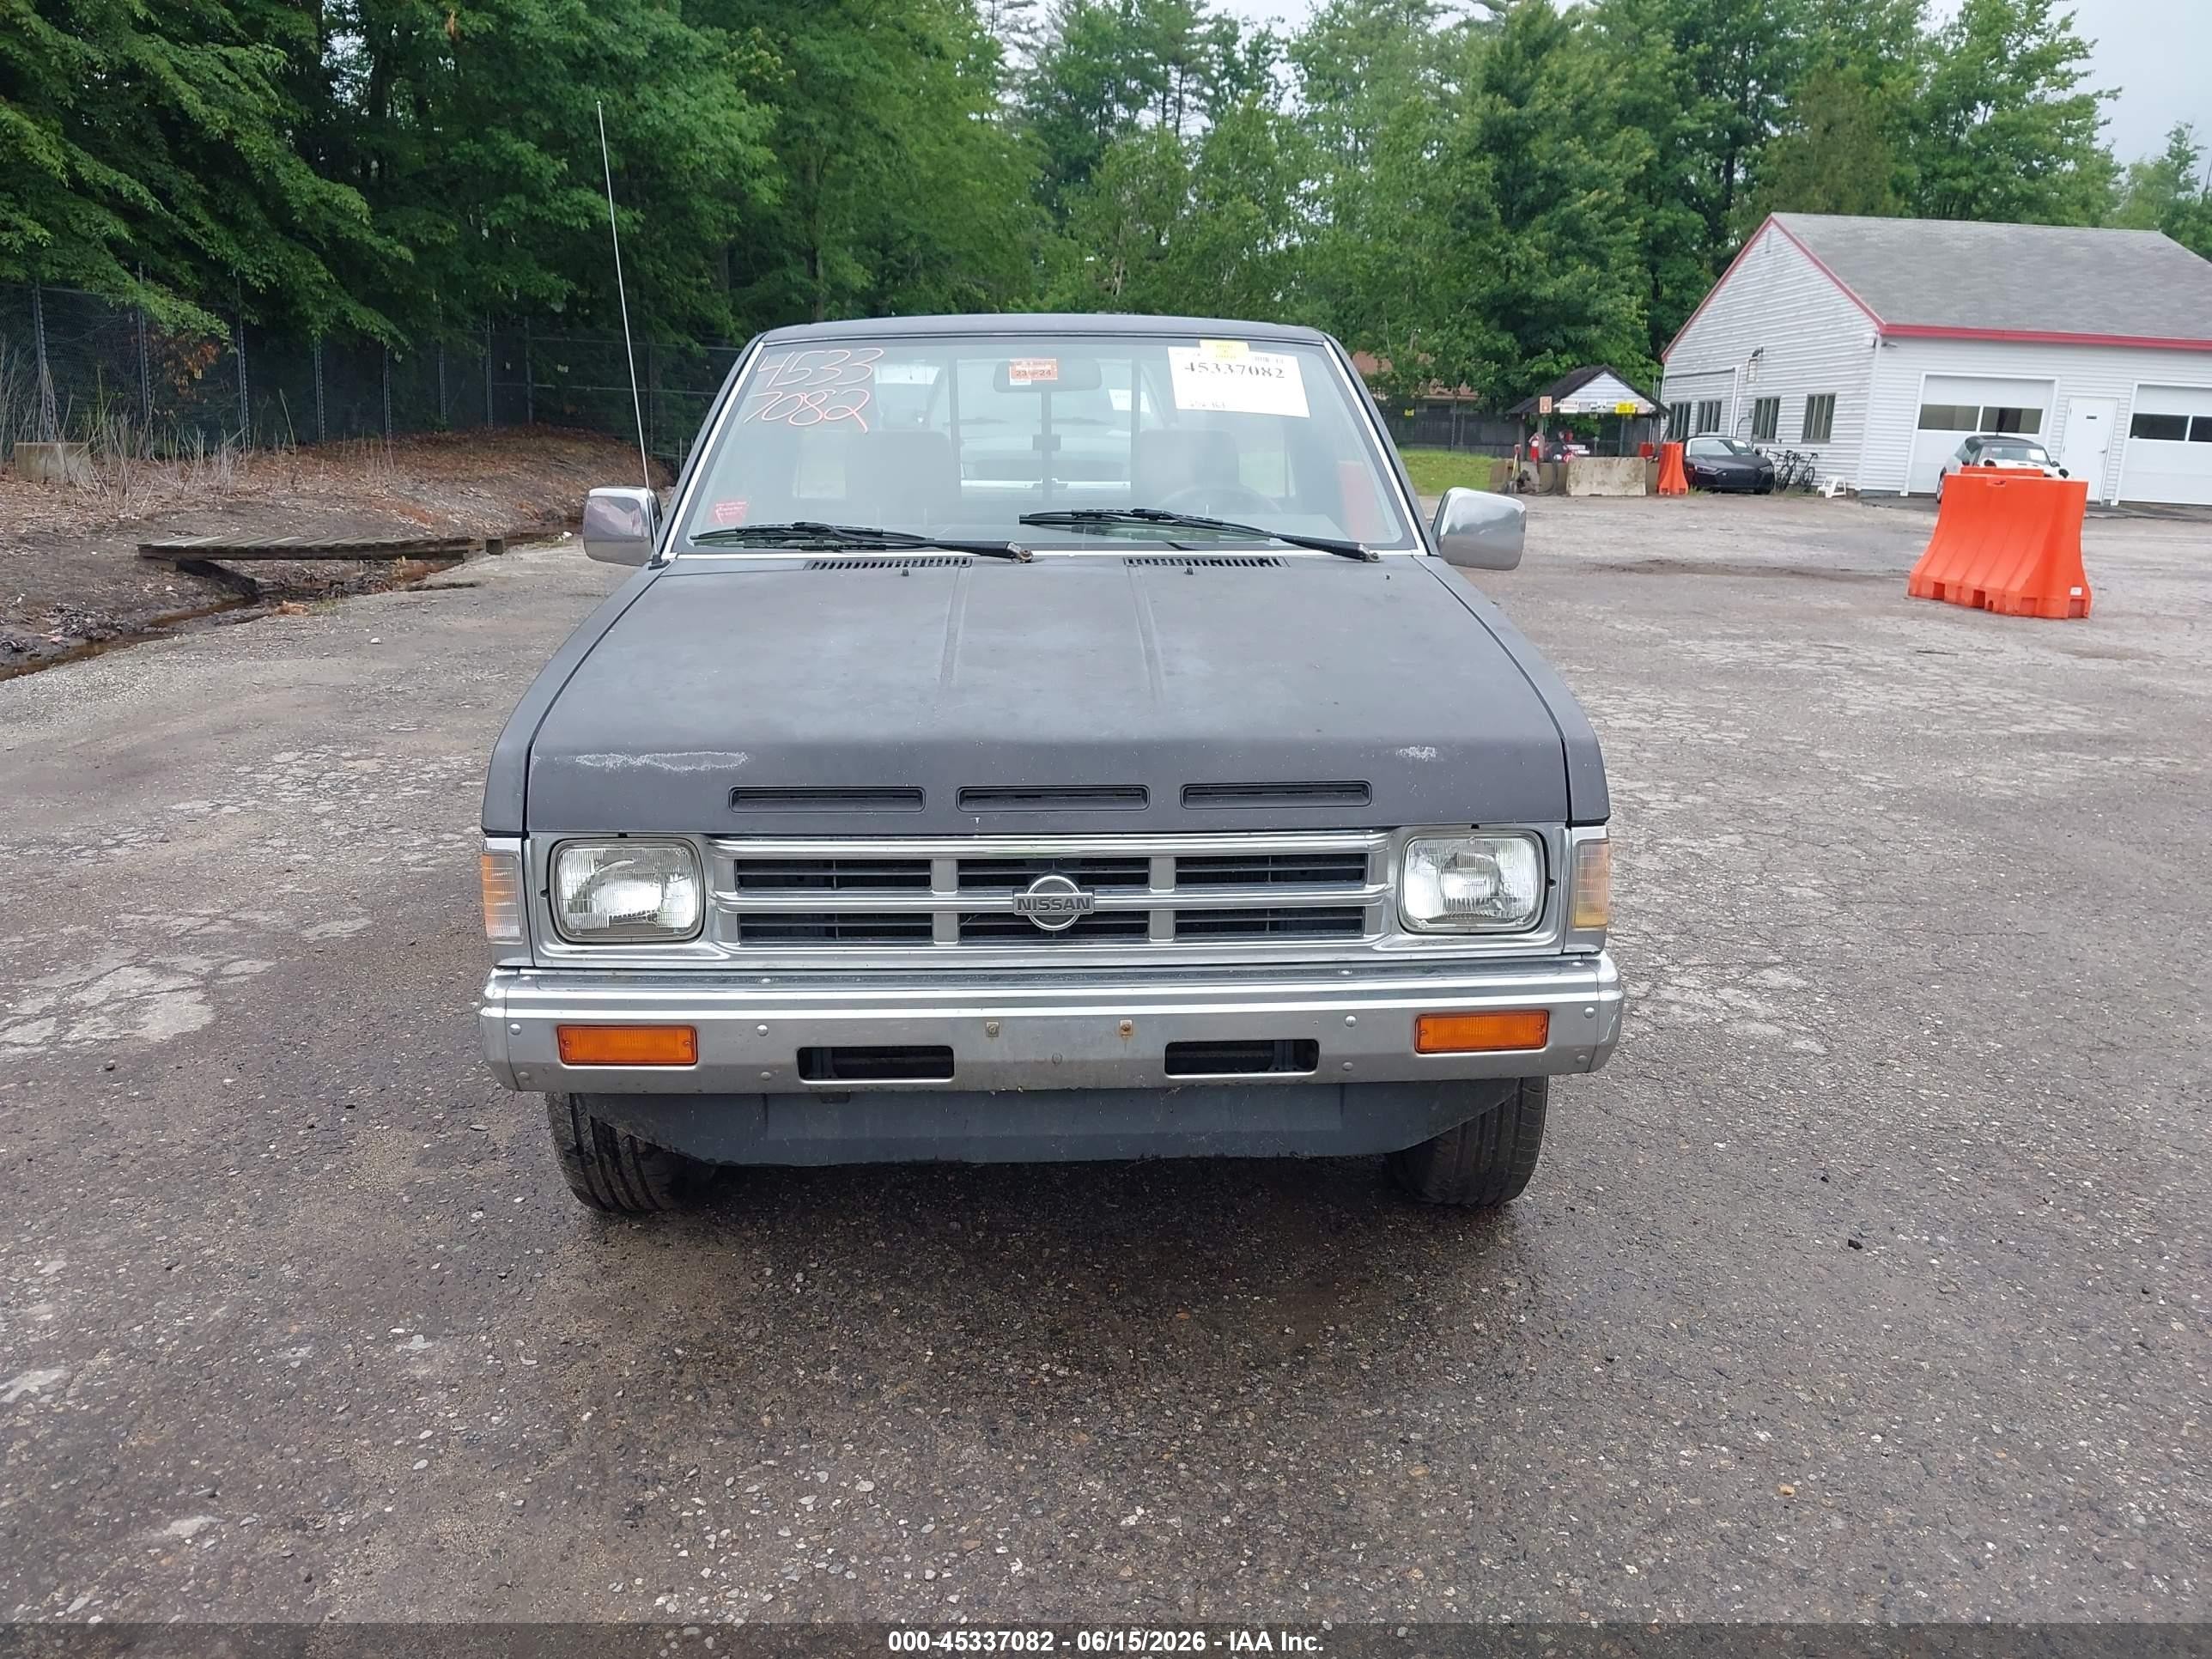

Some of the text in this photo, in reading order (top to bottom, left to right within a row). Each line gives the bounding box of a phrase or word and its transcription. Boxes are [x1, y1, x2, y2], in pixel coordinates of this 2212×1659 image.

[757, 348, 884, 388] 4533
[1184, 362, 1285, 379] 45337082
[744, 388, 871, 434] 7082
[1017, 897, 1091, 911] NISSAN
